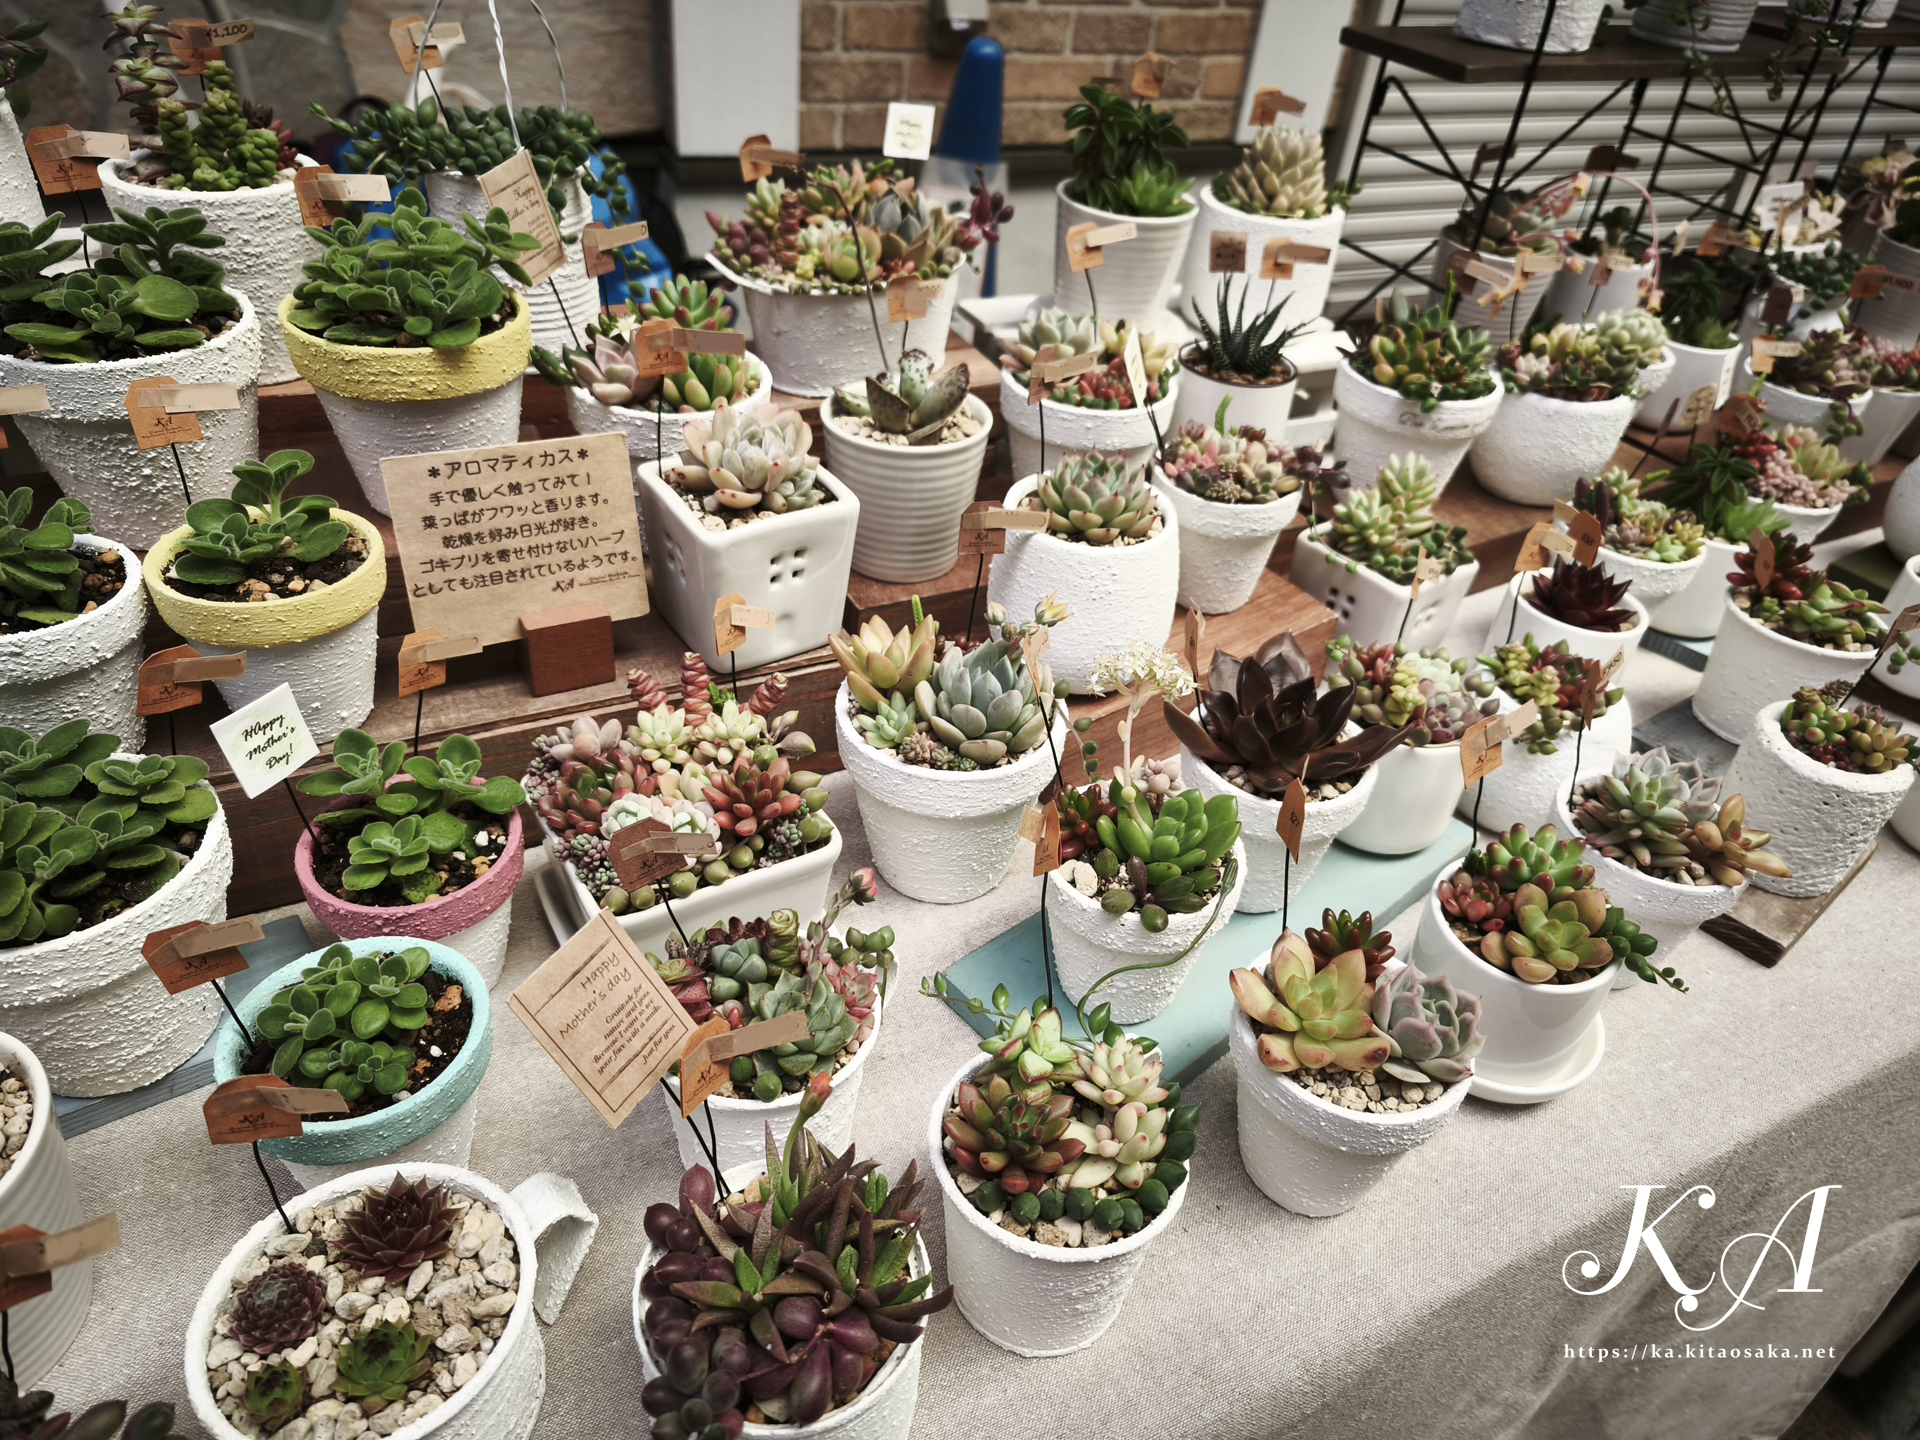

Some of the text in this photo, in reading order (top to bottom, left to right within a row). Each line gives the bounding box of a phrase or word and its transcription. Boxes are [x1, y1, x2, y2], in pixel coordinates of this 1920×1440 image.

[205, 23, 247, 43] ¥1,100
[246, 726, 296, 760] Mother's
[266, 743, 294, 769] Day!
[580, 952, 620, 990] Happy
[559, 967, 631, 1040] Mother's day
[603, 990, 651, 1040] nature and you.
[605, 983, 643, 1024] Gratitude for
[593, 1037, 618, 1064] Because
[624, 1015, 639, 1033] want
[638, 1009, 645, 1017] to
[645, 998, 654, 1009] see
[597, 1055, 613, 1076] your
[612, 1044, 625, 1061] face
[626, 1027, 640, 1044] with
[643, 1024, 677, 1065] Just for you.
